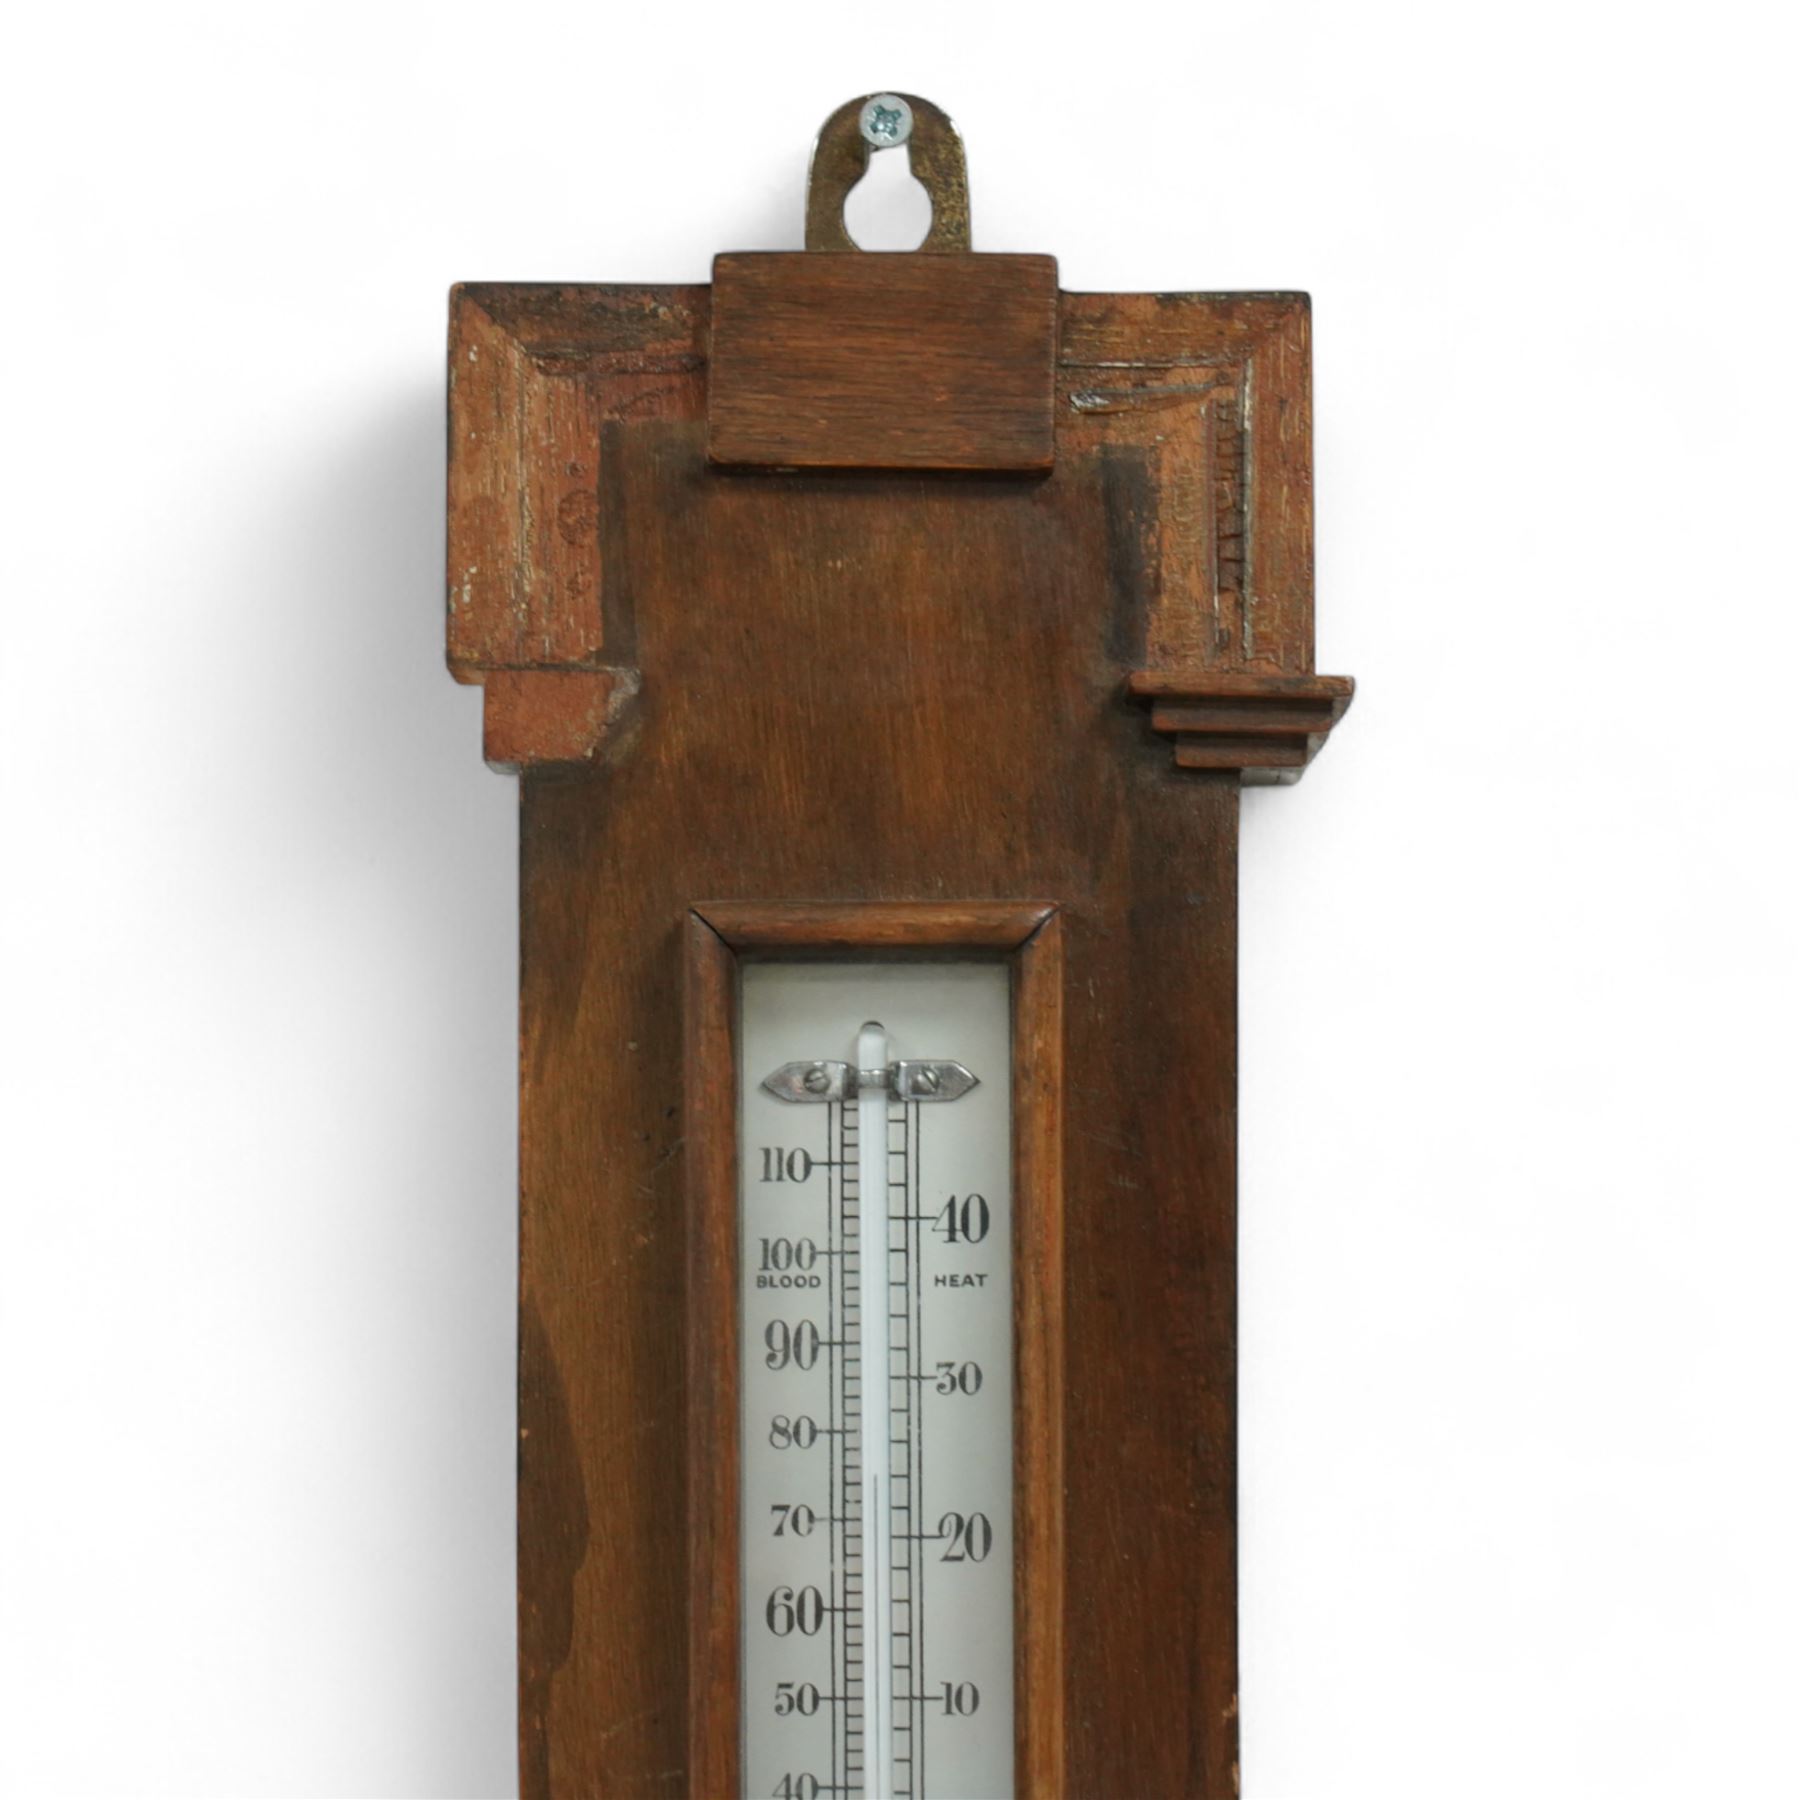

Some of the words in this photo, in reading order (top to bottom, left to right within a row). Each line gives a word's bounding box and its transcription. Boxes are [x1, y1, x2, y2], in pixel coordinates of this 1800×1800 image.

[760, 1148, 812, 1183] 110
[932, 1193, 990, 1244] 40
[759, 1238, 817, 1271] 100
[756, 1274, 822, 1289] BLOOD
[934, 1273, 988, 1288] HEAT
[764, 1320, 819, 1370] 90
[935, 1362, 983, 1396] 30
[768, 1415, 818, 1450] 80
[770, 1504, 815, 1537] 70
[938, 1512, 993, 1562] 20
[765, 1586, 824, 1637] 60
[774, 1682, 820, 1716] 50
[941, 1681, 980, 1716] 10
[772, 1773, 819, 1800] 40
